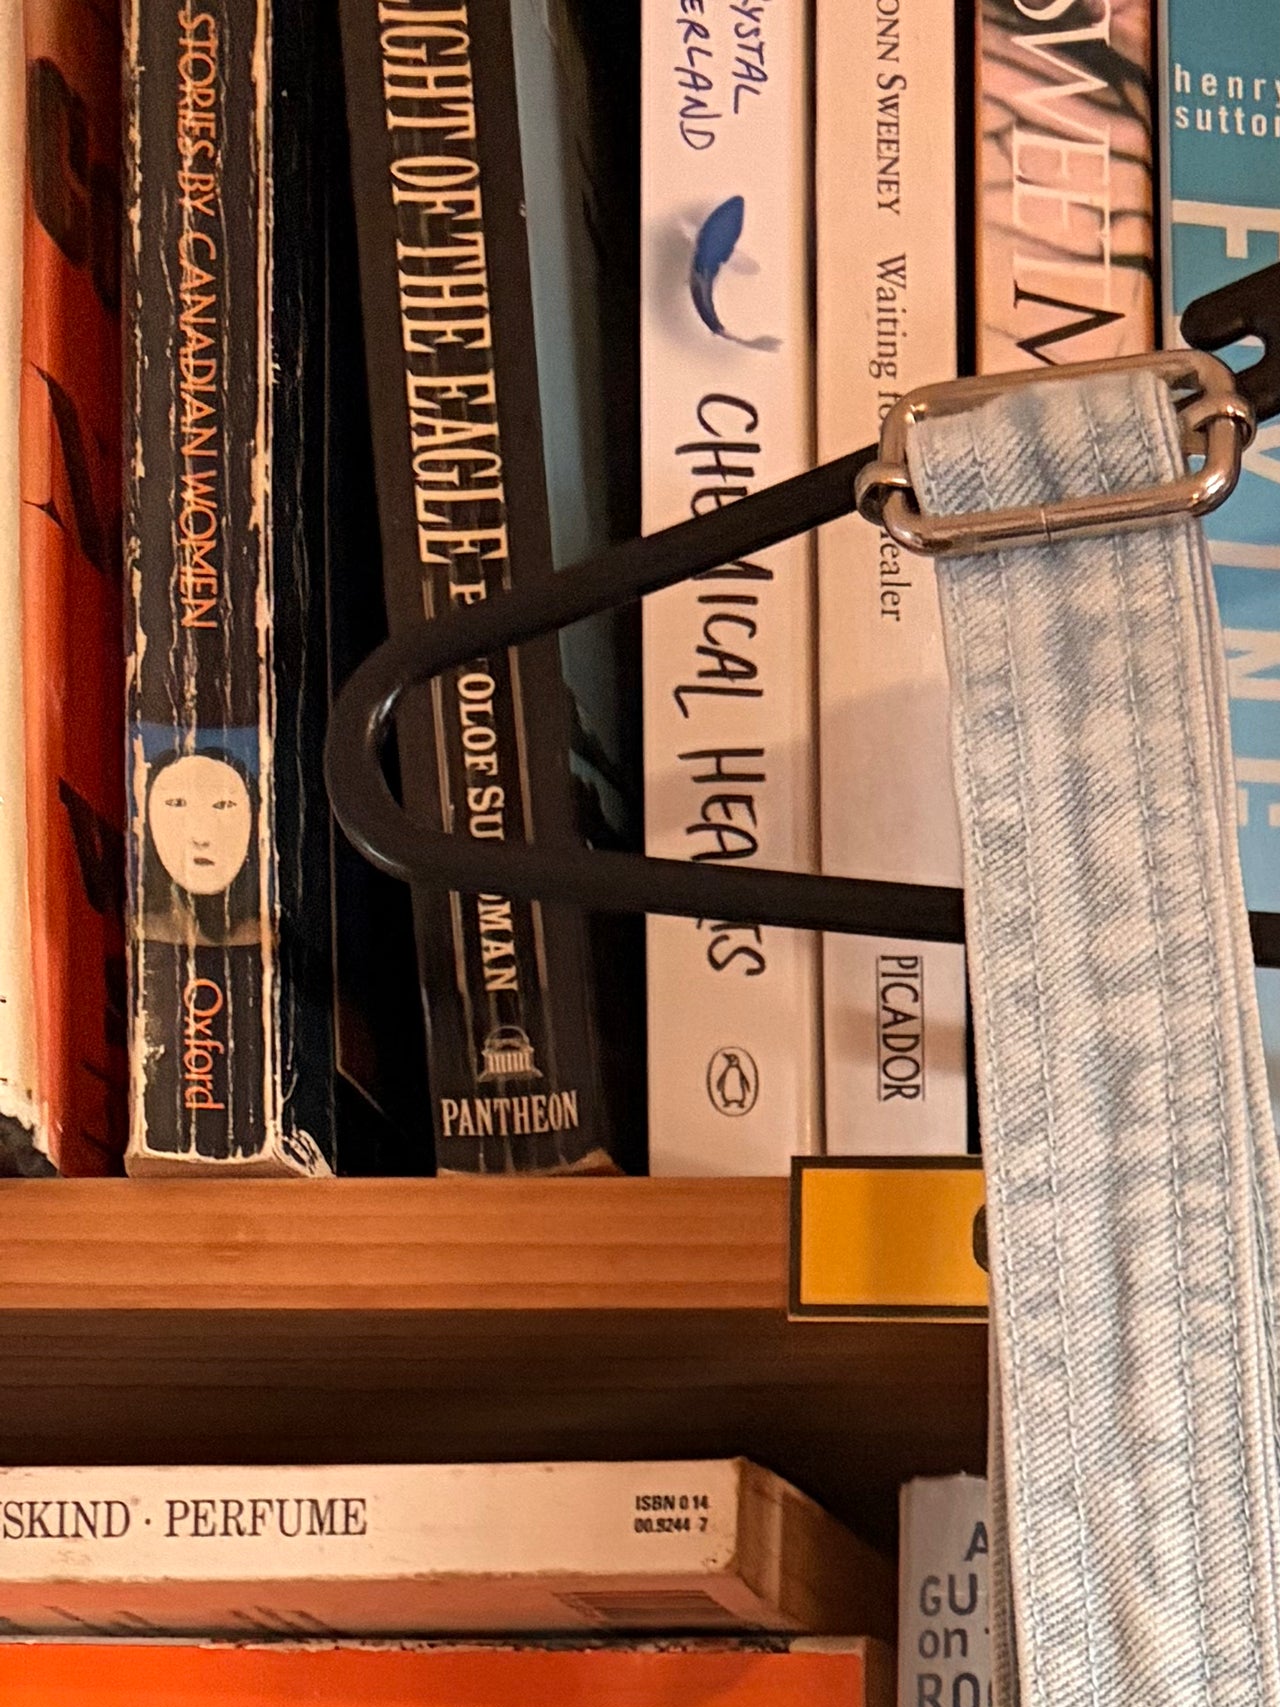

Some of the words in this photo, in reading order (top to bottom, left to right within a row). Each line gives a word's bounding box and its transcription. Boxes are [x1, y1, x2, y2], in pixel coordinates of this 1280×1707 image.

[176, 12, 217, 159] STORIES
[378, 0, 476, 140] IGHT
[176, 171, 217, 217] BY
[390, 155, 483, 221] OF
[877, 73, 907, 217] SWEENEY
[177, 235, 218, 458] CANADIAN
[396, 231, 493, 354] THE
[869, 253, 908, 380] Waiting
[406, 368, 509, 565] EAGLE
[180, 466, 219, 629] WOMEN
[457, 672, 500, 776] OLOF
[183, 978, 224, 1111] Oxford
[880, 955, 921, 1101] PICADOR
[441, 1090, 579, 1137] PANTHEON
[163, 1498, 369, 1539] PERFUME
[635, 1495, 675, 1512] ISBN
[918, 1625, 968, 1660] on
